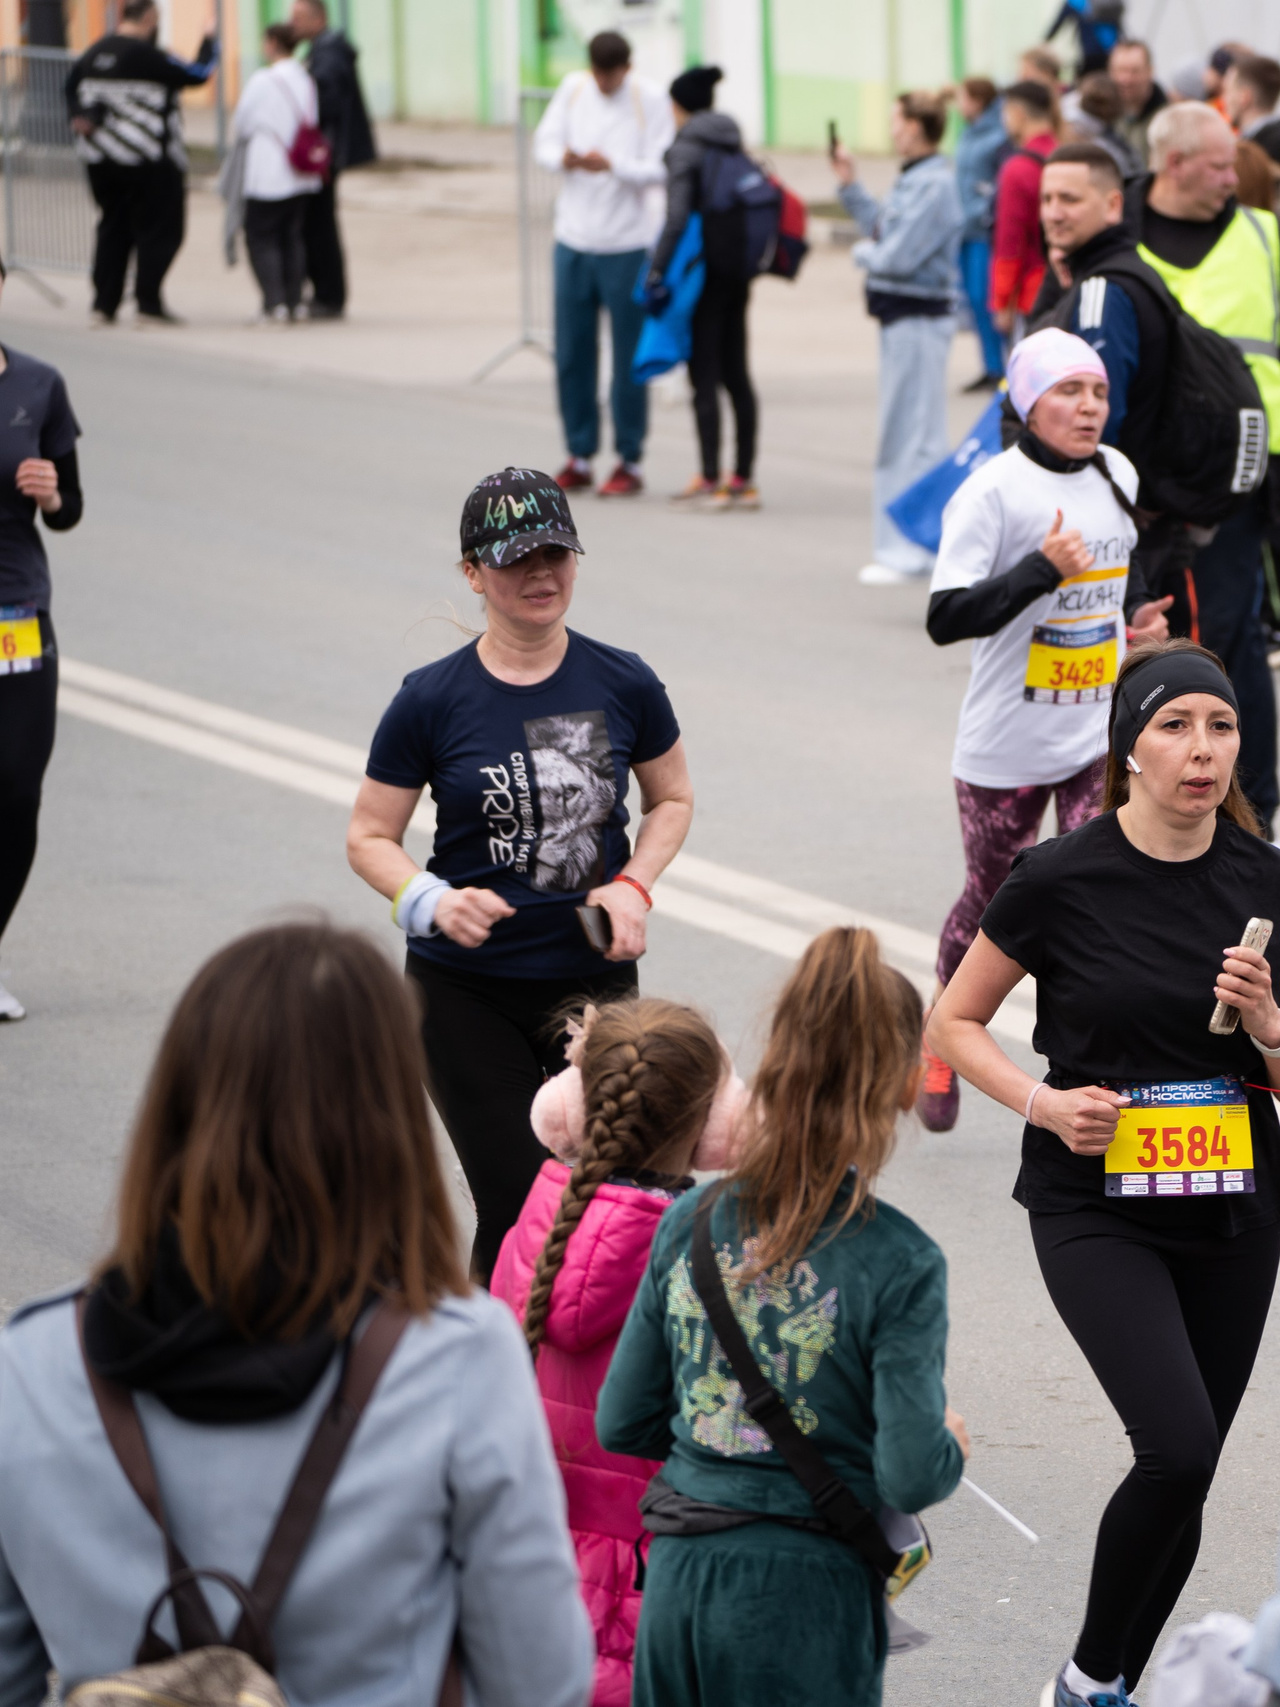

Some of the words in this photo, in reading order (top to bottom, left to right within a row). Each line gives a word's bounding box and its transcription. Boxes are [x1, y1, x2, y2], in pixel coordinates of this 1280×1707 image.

[1049, 657, 1105, 686] 3429
[1151, 1091, 1213, 1101] КОСМОС
[1162, 1083, 1212, 1092] ПРОСТО
[1137, 1125, 1231, 1168] 3584
